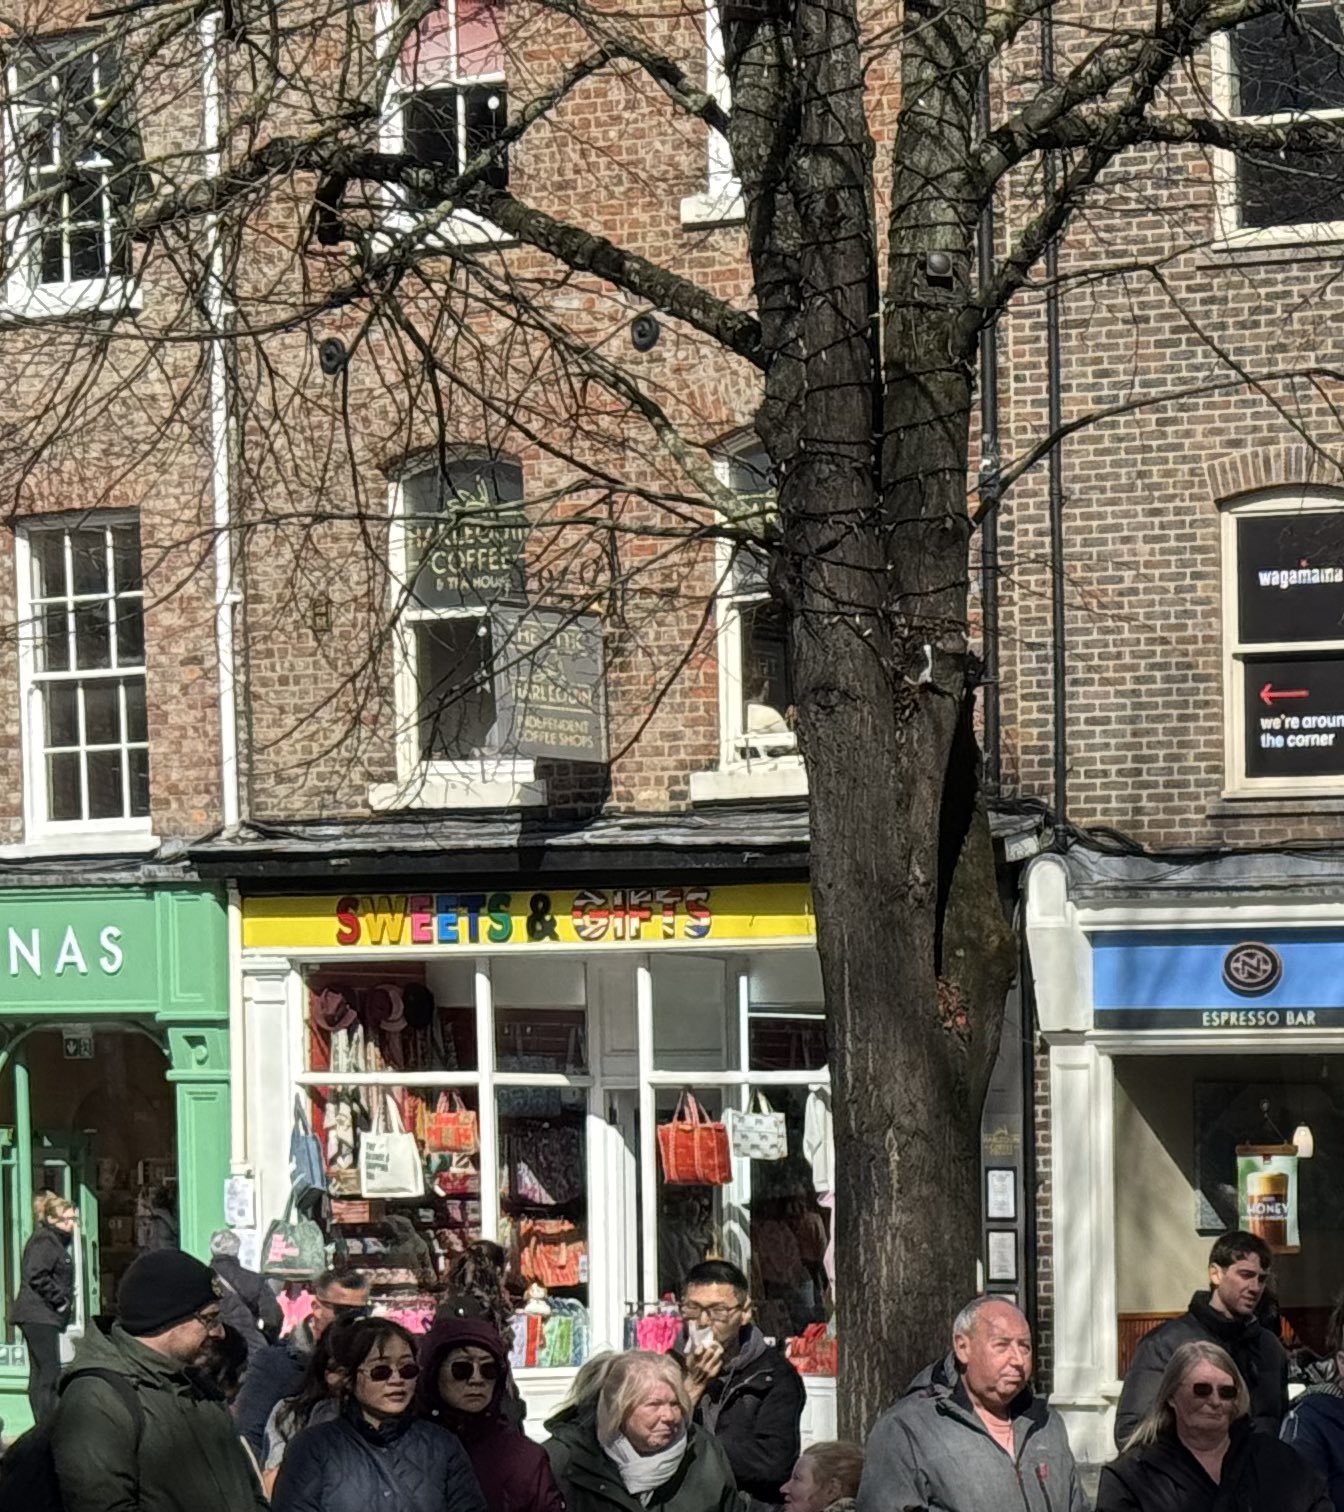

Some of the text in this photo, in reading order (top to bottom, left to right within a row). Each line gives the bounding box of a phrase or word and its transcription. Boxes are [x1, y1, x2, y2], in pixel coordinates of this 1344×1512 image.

[431, 547, 511, 575] COFFEE
[1258, 567, 1344, 589] wagamama
[1259, 714, 1300, 730] we're
[1260, 733, 1336, 748] the corner
[335, 888, 712, 946] SWEETS & GIFTS
[8, 925, 125, 977] NAS
[1202, 1010, 1317, 1027] ESPRESSO BAR
[1246, 1202, 1289, 1215] HONEY
